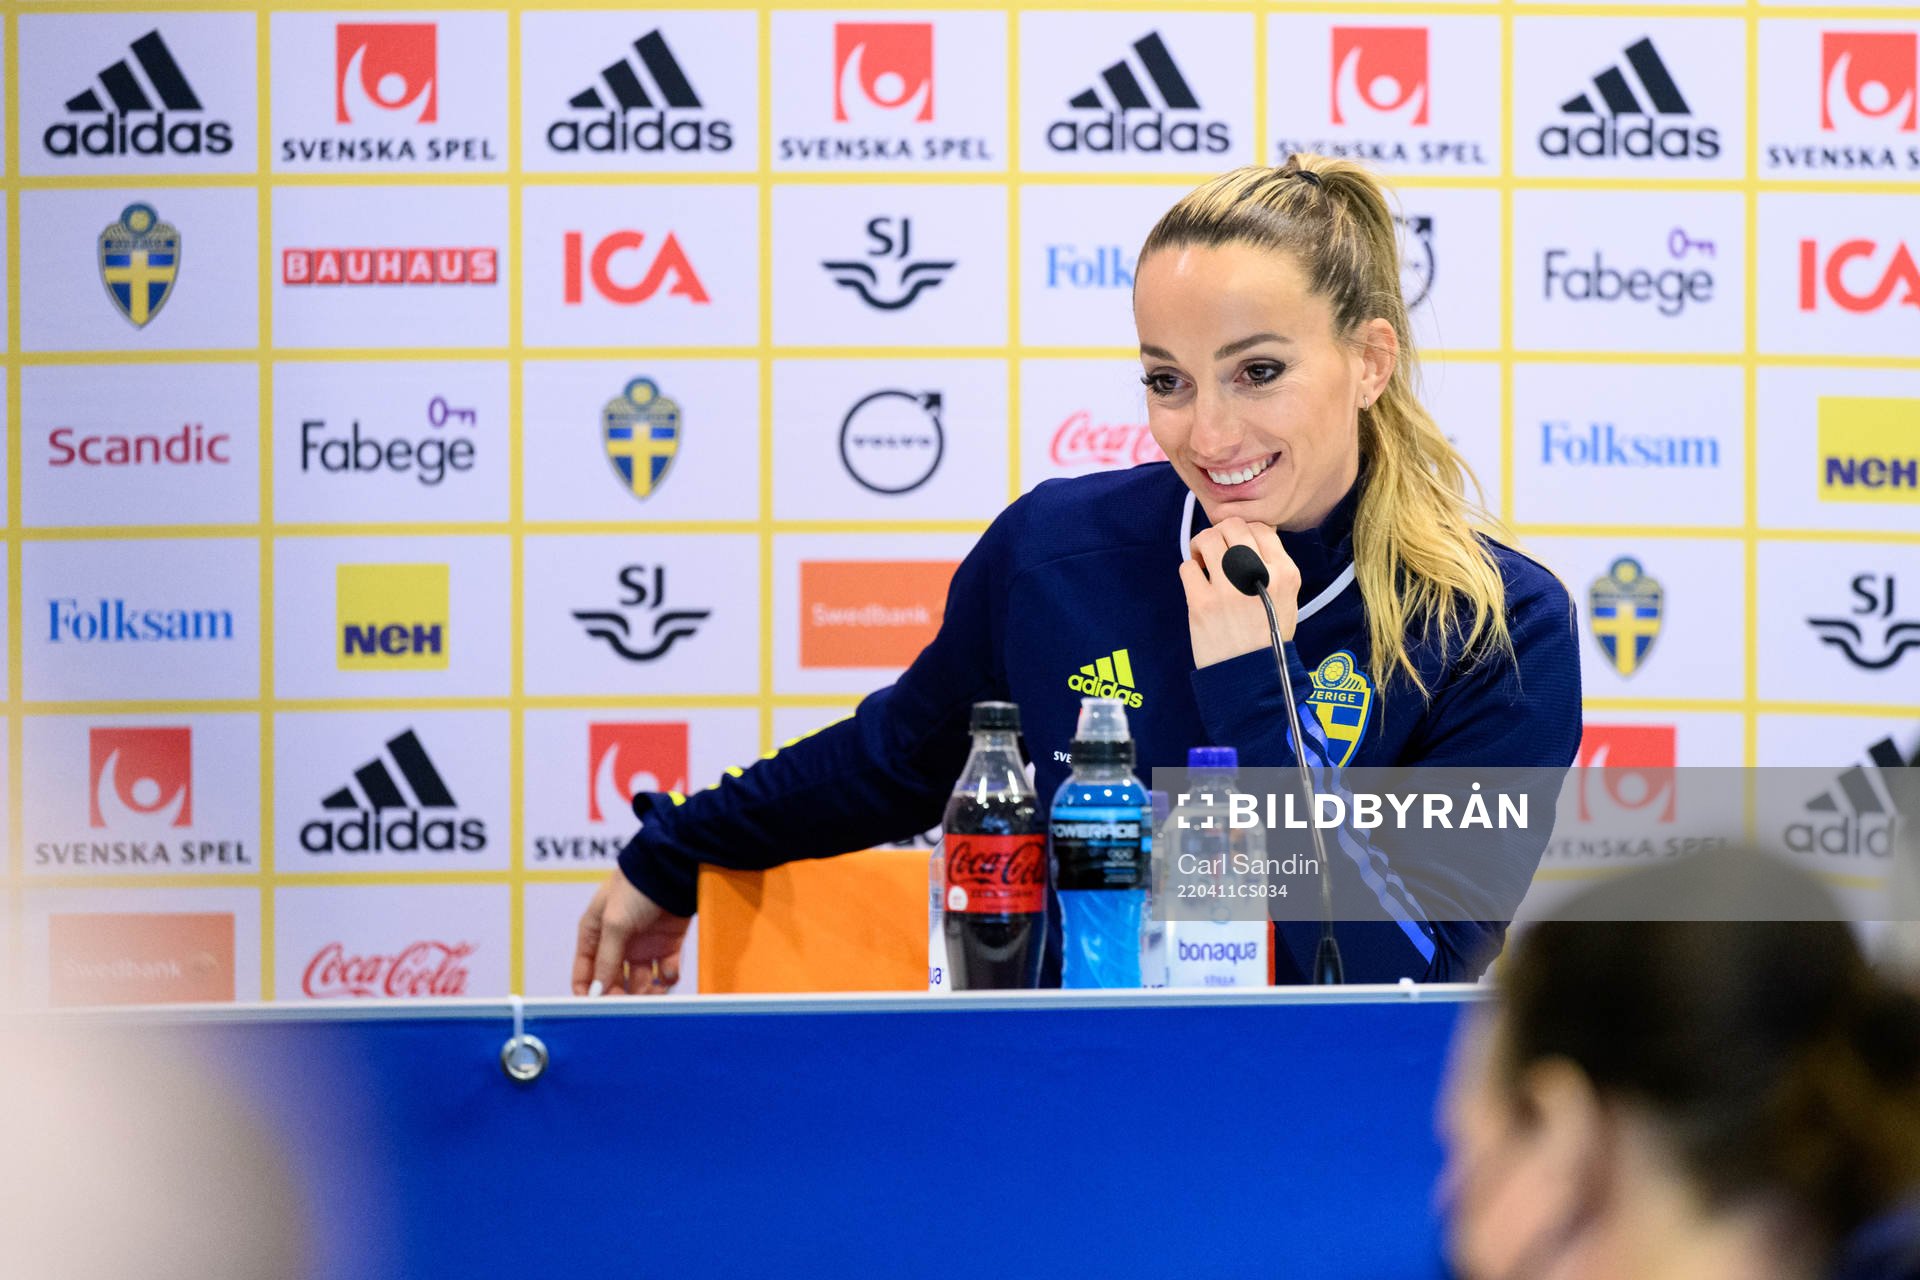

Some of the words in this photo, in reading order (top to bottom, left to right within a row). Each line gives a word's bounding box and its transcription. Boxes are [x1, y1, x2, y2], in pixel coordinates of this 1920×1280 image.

[43, 111, 233, 157] adidas
[281, 138, 415, 162] SVENSKA
[426, 138, 497, 162] SPEL
[546, 109, 734, 154] adidas
[779, 137, 910, 161] SVENSKA
[922, 138, 993, 161] SPEL
[1046, 108, 1231, 154] adidas
[1539, 113, 1721, 160] adidas
[1419, 141, 1488, 165] SPEL
[1768, 145, 1896, 169] SVENSKA
[866, 217, 912, 258] SJ
[282, 248, 498, 285] BAUHAUS
[564, 229, 711, 305] ICA
[1544, 249, 1715, 317] Fabege
[1799, 237, 1920, 313] ICA
[48, 424, 230, 467] Scandic
[301, 421, 475, 485] Fabege
[1540, 422, 1720, 467] Folksam
[619, 565, 664, 608] SJ
[1851, 574, 1896, 618] SJ
[47, 600, 234, 642] Folksam
[811, 602, 930, 627] Swedbank
[1067, 674, 1144, 708] adidas
[300, 806, 486, 853] adidas
[36, 840, 169, 866] SVENSKA
[181, 840, 251, 865] SPEL
[1178, 939, 1257, 965] bonaqua
